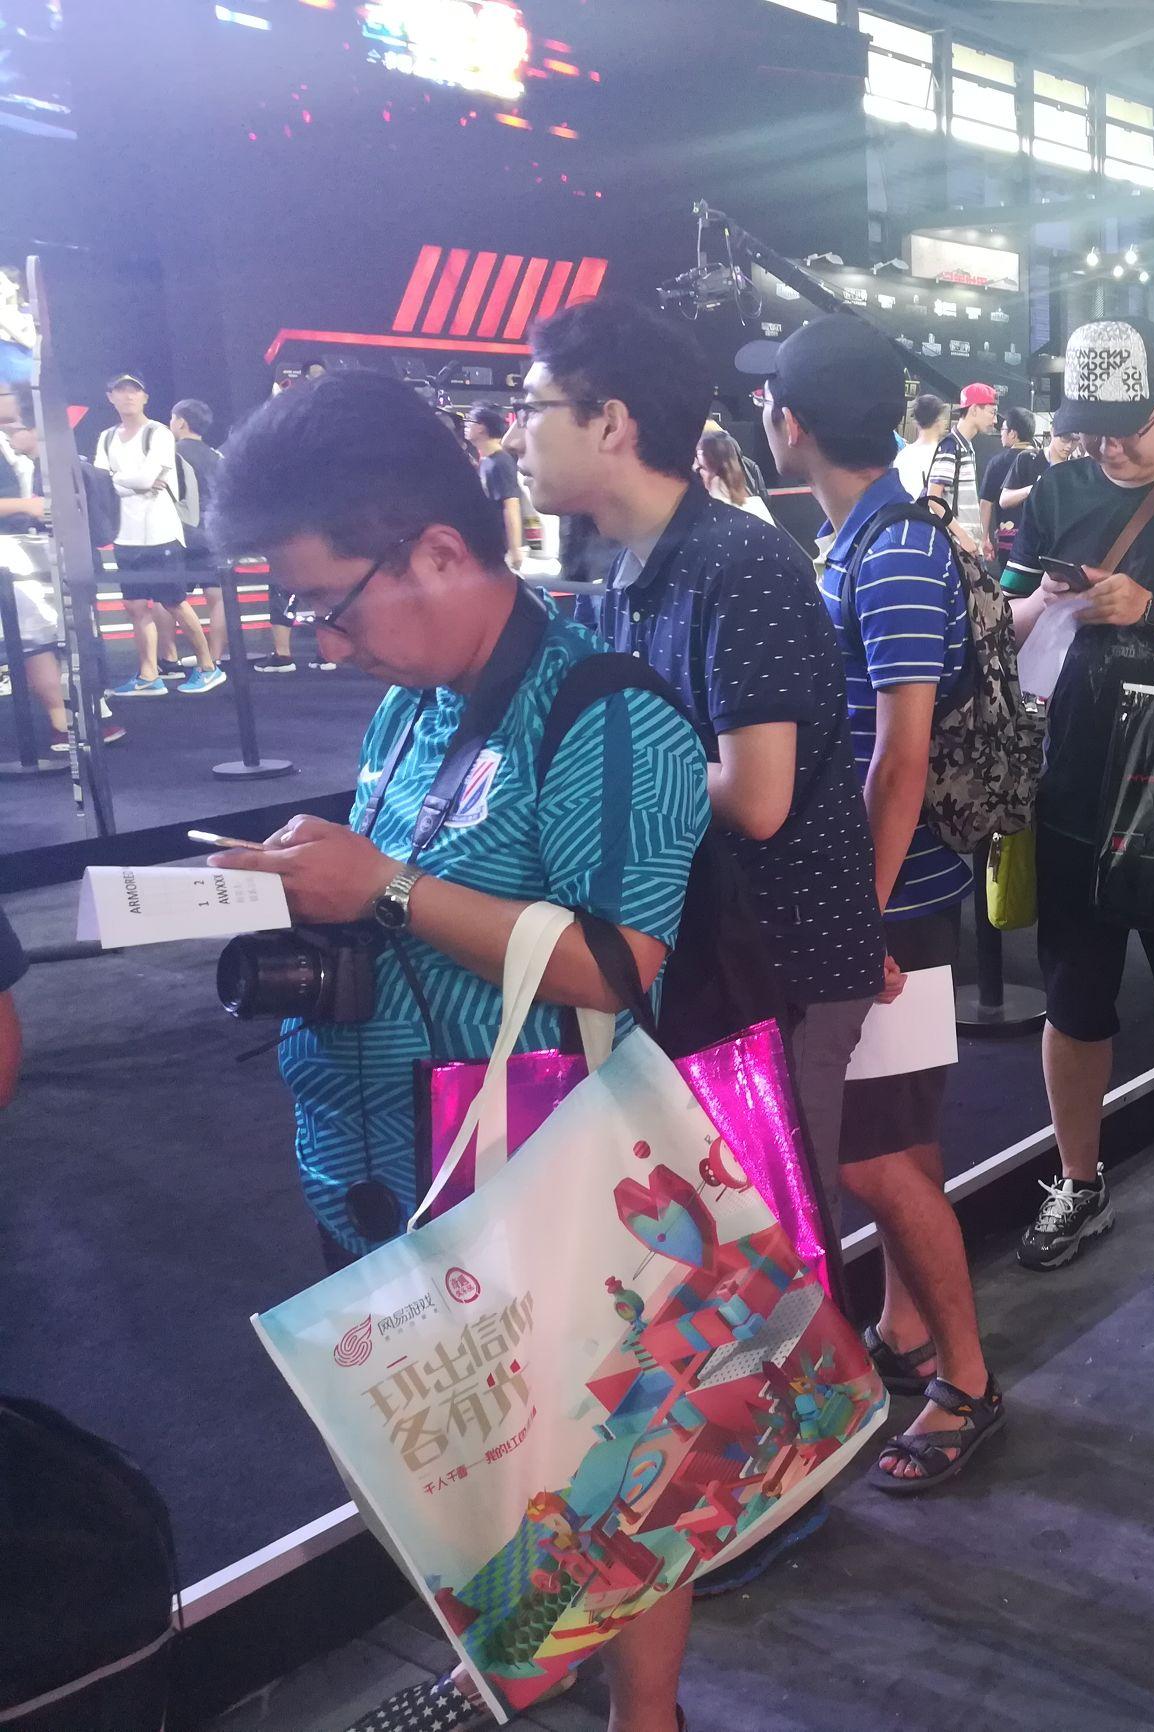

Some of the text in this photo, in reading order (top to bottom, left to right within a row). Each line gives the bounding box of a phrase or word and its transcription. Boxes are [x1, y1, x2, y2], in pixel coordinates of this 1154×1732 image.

[199, 900, 209, 908] 1
[377, 1291, 436, 1337] 网易游戏
